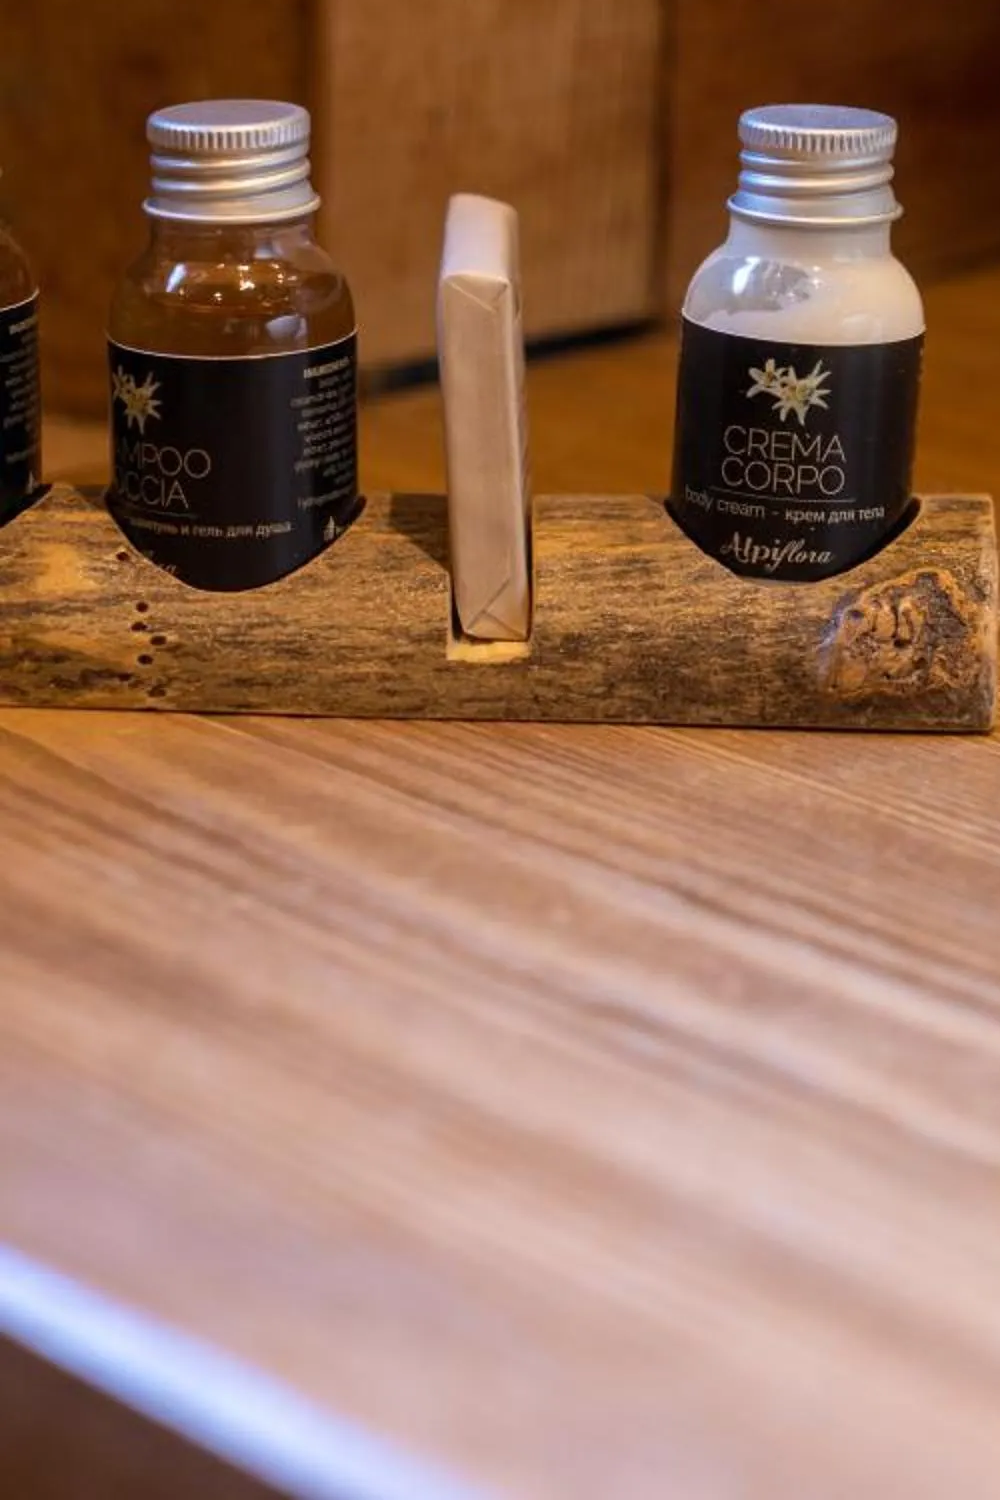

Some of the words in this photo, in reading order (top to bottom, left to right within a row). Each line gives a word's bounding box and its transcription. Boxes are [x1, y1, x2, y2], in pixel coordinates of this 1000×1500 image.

[119, 436, 211, 479] MPOO
[723, 425, 847, 464] CREMA
[721, 456, 845, 495] CORPO
[685, 484, 713, 511] body
[717, 499, 765, 519] cream
[784, 508, 825, 524] крем
[827, 509, 855, 524] для
[859, 506, 886, 521] тела
[720, 531, 834, 573] Alpiflora
